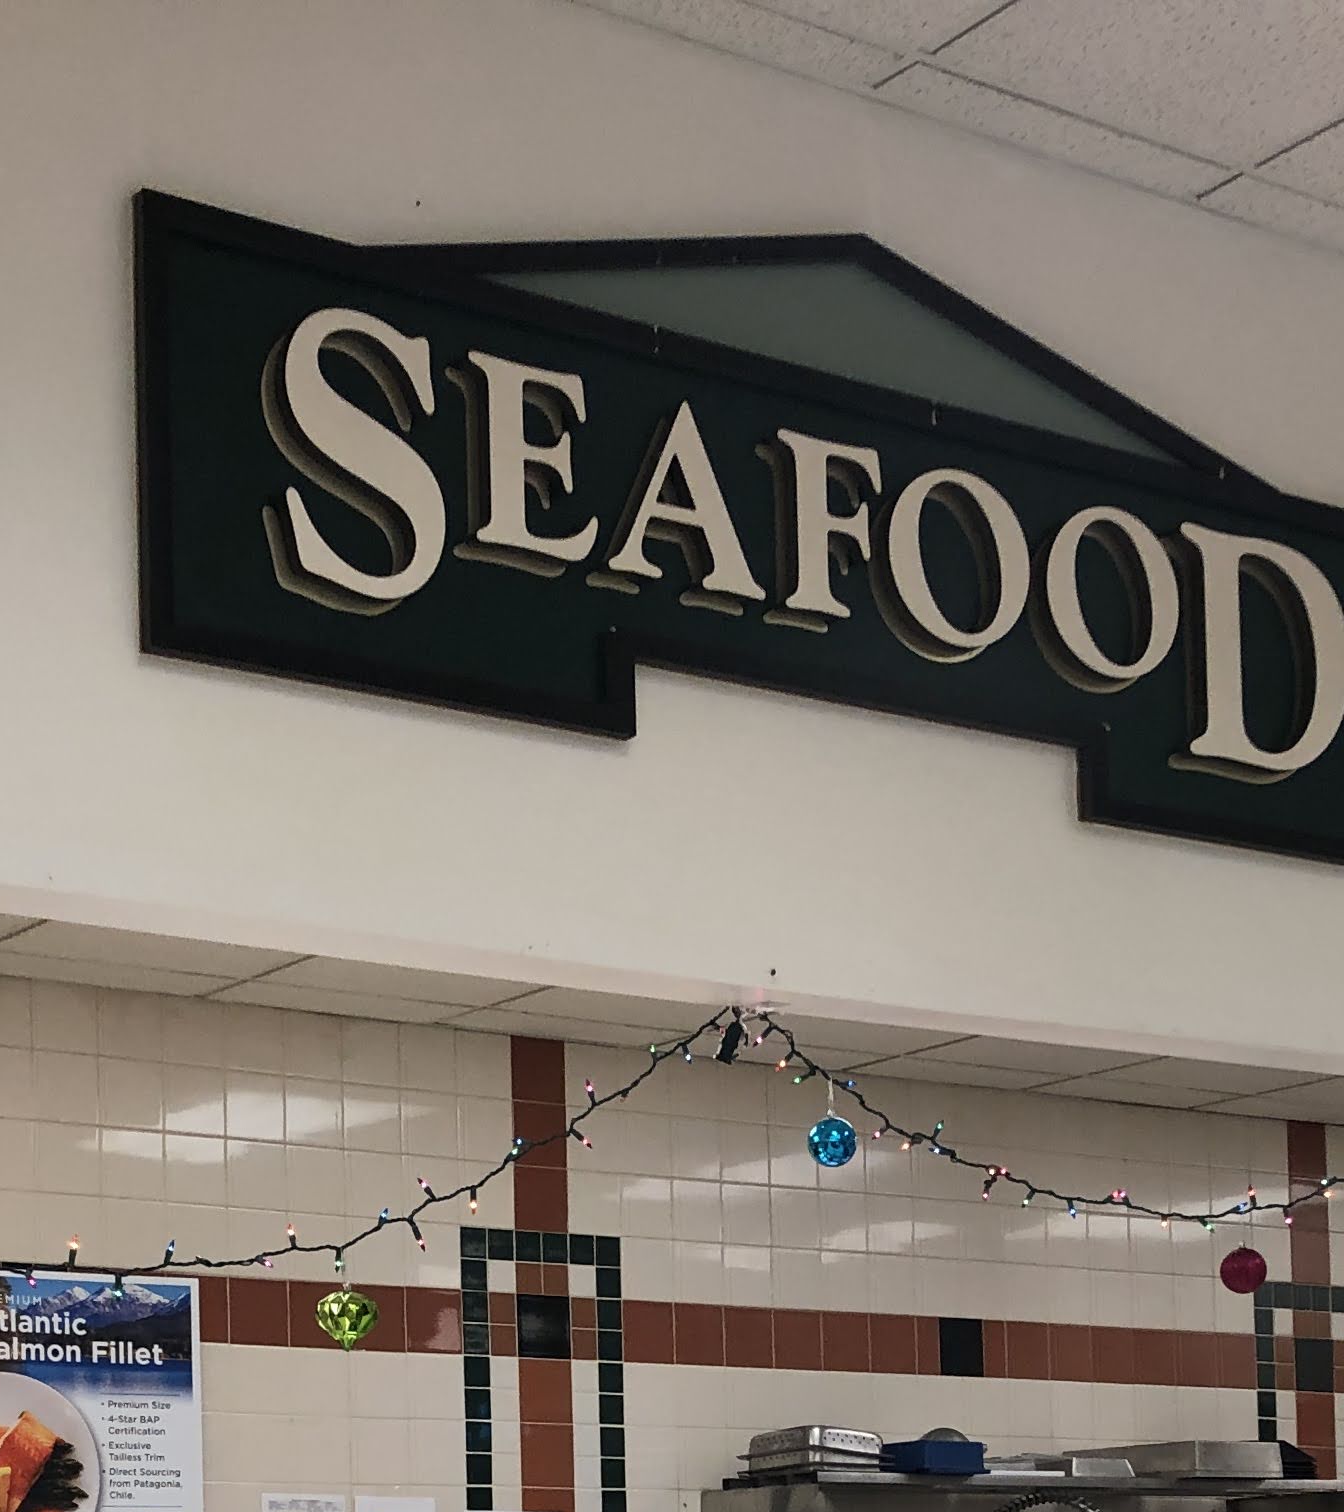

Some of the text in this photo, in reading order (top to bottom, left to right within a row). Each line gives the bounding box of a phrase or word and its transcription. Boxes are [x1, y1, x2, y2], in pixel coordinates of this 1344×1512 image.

[91, 1341, 164, 1366] Fillet
[107, 1400, 172, 1410] Premium Size
[107, 1415, 161, 1424] 4-Star BAP
[108, 1426, 167, 1436] Certification
[108, 1441, 152, 1450] Exclusive
[109, 1453, 166, 1462] Tailless Trim
[109, 1468, 182, 1479] Direct Sourcing
[109, 1480, 131, 1488] from
